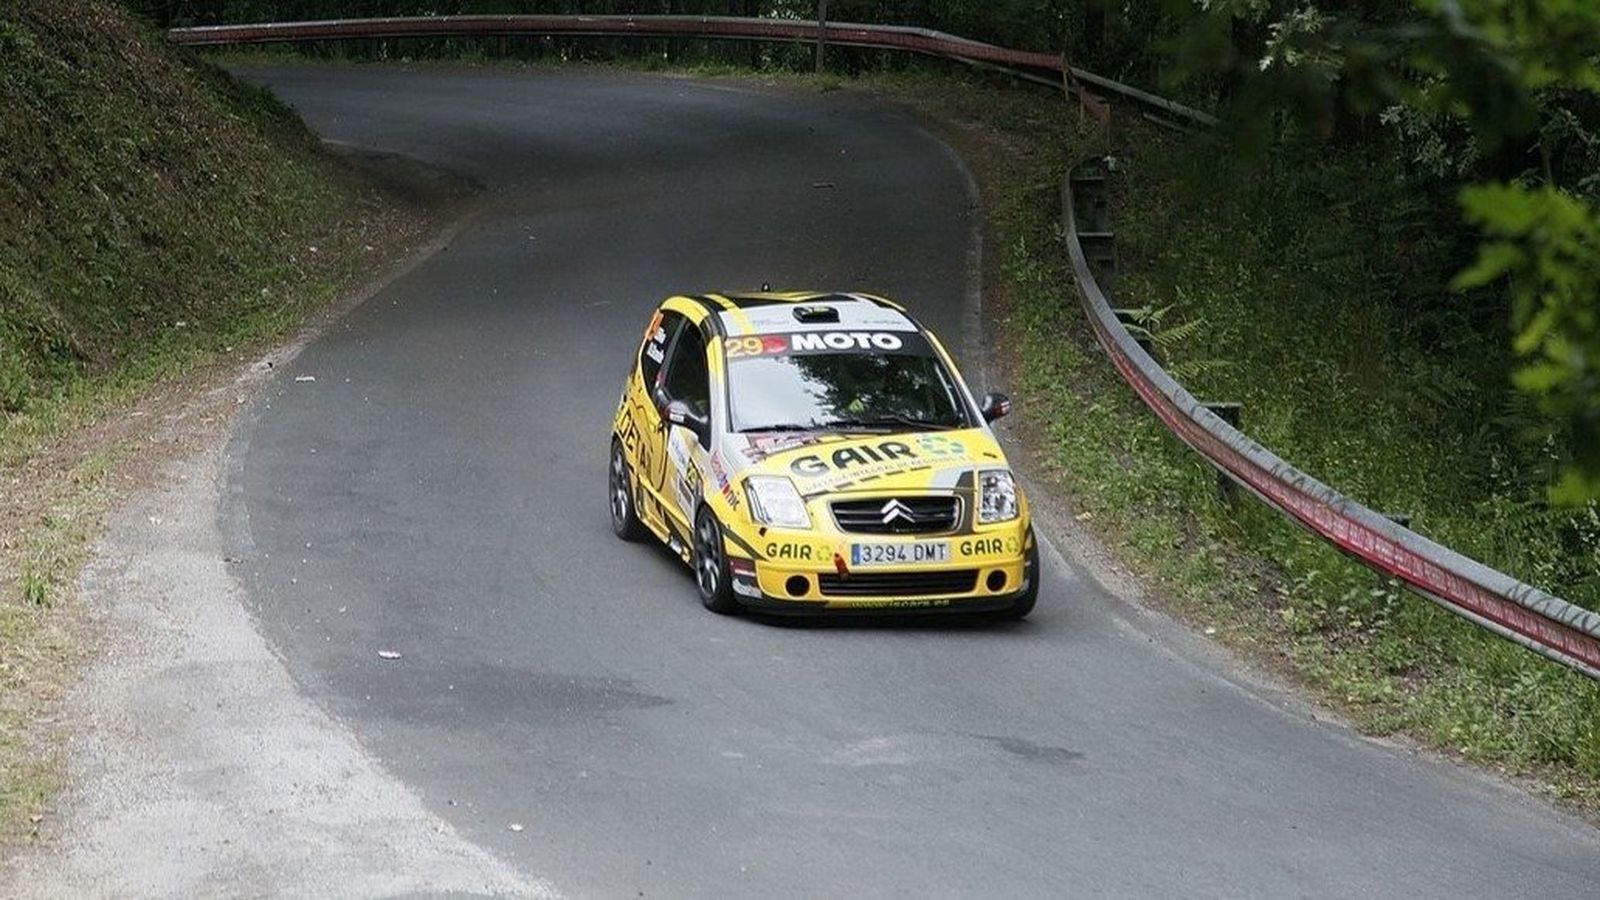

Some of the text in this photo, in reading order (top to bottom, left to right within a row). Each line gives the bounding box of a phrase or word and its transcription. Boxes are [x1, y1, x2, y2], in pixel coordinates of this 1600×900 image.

[725, 337, 763, 358] 29
[791, 333, 904, 351] MOTO
[790, 441, 920, 477] GAIR
[765, 542, 813, 560] GAIR
[862, 543, 946, 562] 3294 DMT
[960, 539, 1003, 556] GAIR
